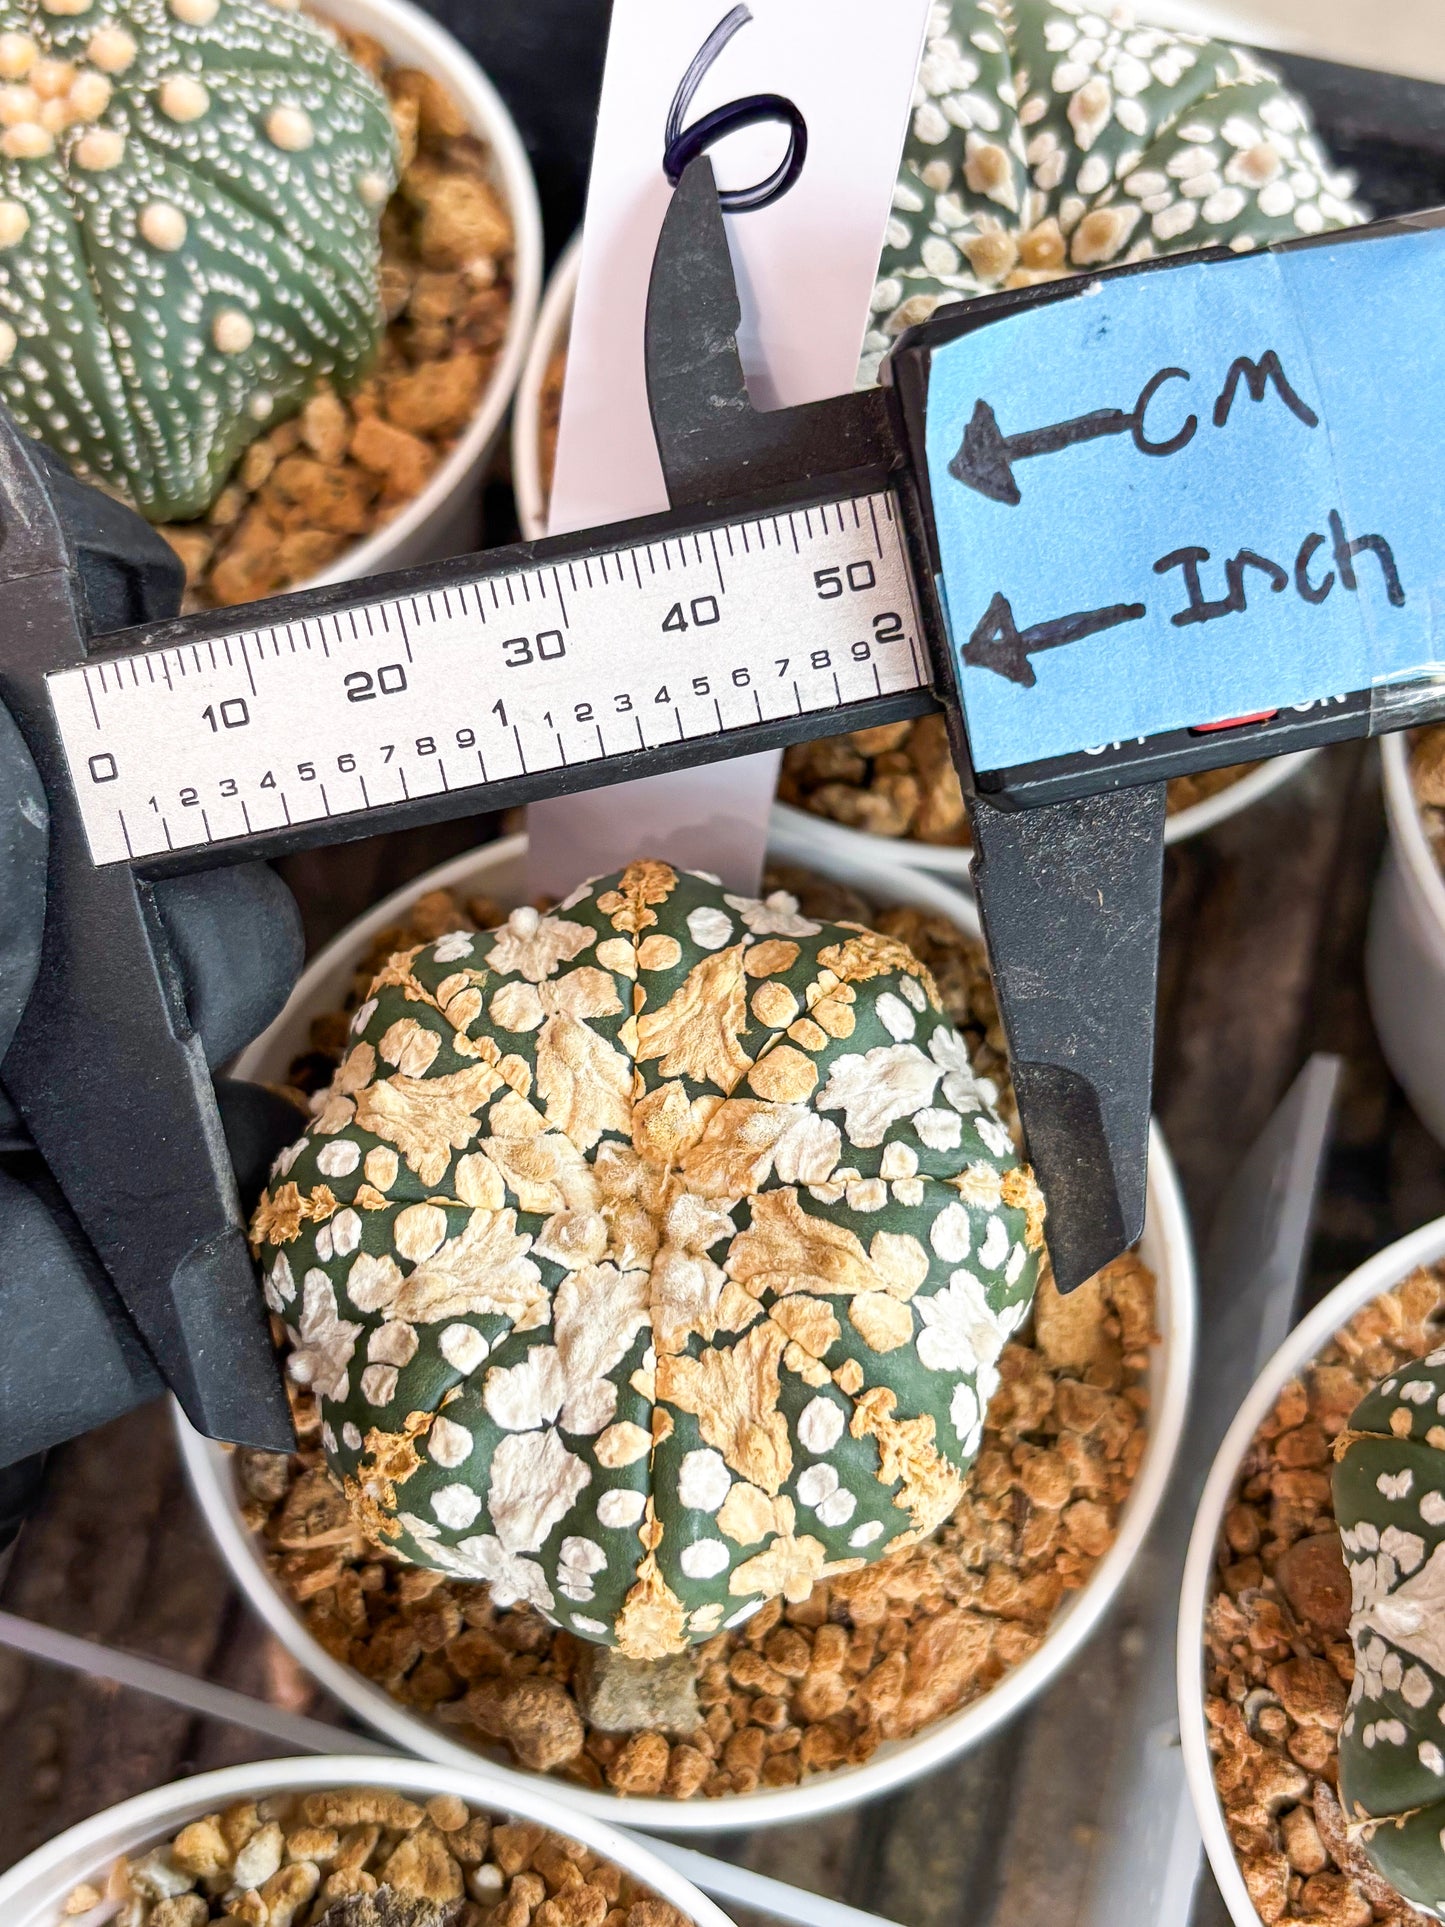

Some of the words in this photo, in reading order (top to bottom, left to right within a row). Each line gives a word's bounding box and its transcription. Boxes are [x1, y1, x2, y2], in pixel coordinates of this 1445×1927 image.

[663, 3, 808, 214] 6
[1153, 509, 1406, 627] Inch
[88, 752, 119, 784] 0
[201, 697, 250, 733] 10
[343, 663, 408, 703] 20
[502, 629, 567, 668] 30
[661, 595, 721, 634] 40
[813, 560, 877, 600] 50
[148, 795, 159, 812] 1
[179, 787, 200, 807] 2
[219, 778, 238, 798] 3
[260, 770, 277, 789] 4
[297, 761, 316, 782] 5
[337, 753, 357, 773] 6
[379, 744, 395, 764] 7
[415, 736, 437, 756] 8
[455, 728, 476, 749] 9
[491, 697, 508, 727] 1
[543, 711, 554, 729] 1
[574, 702, 594, 723] 2
[613, 693, 633, 713] 3
[654, 685, 671, 704] 4
[692, 676, 710, 696] 5
[731, 667, 751, 687] 6
[774, 658, 790, 677] 7
[810, 649, 832, 670] 8
[851, 640, 871, 662] 9
[872, 611, 905, 645] 2
